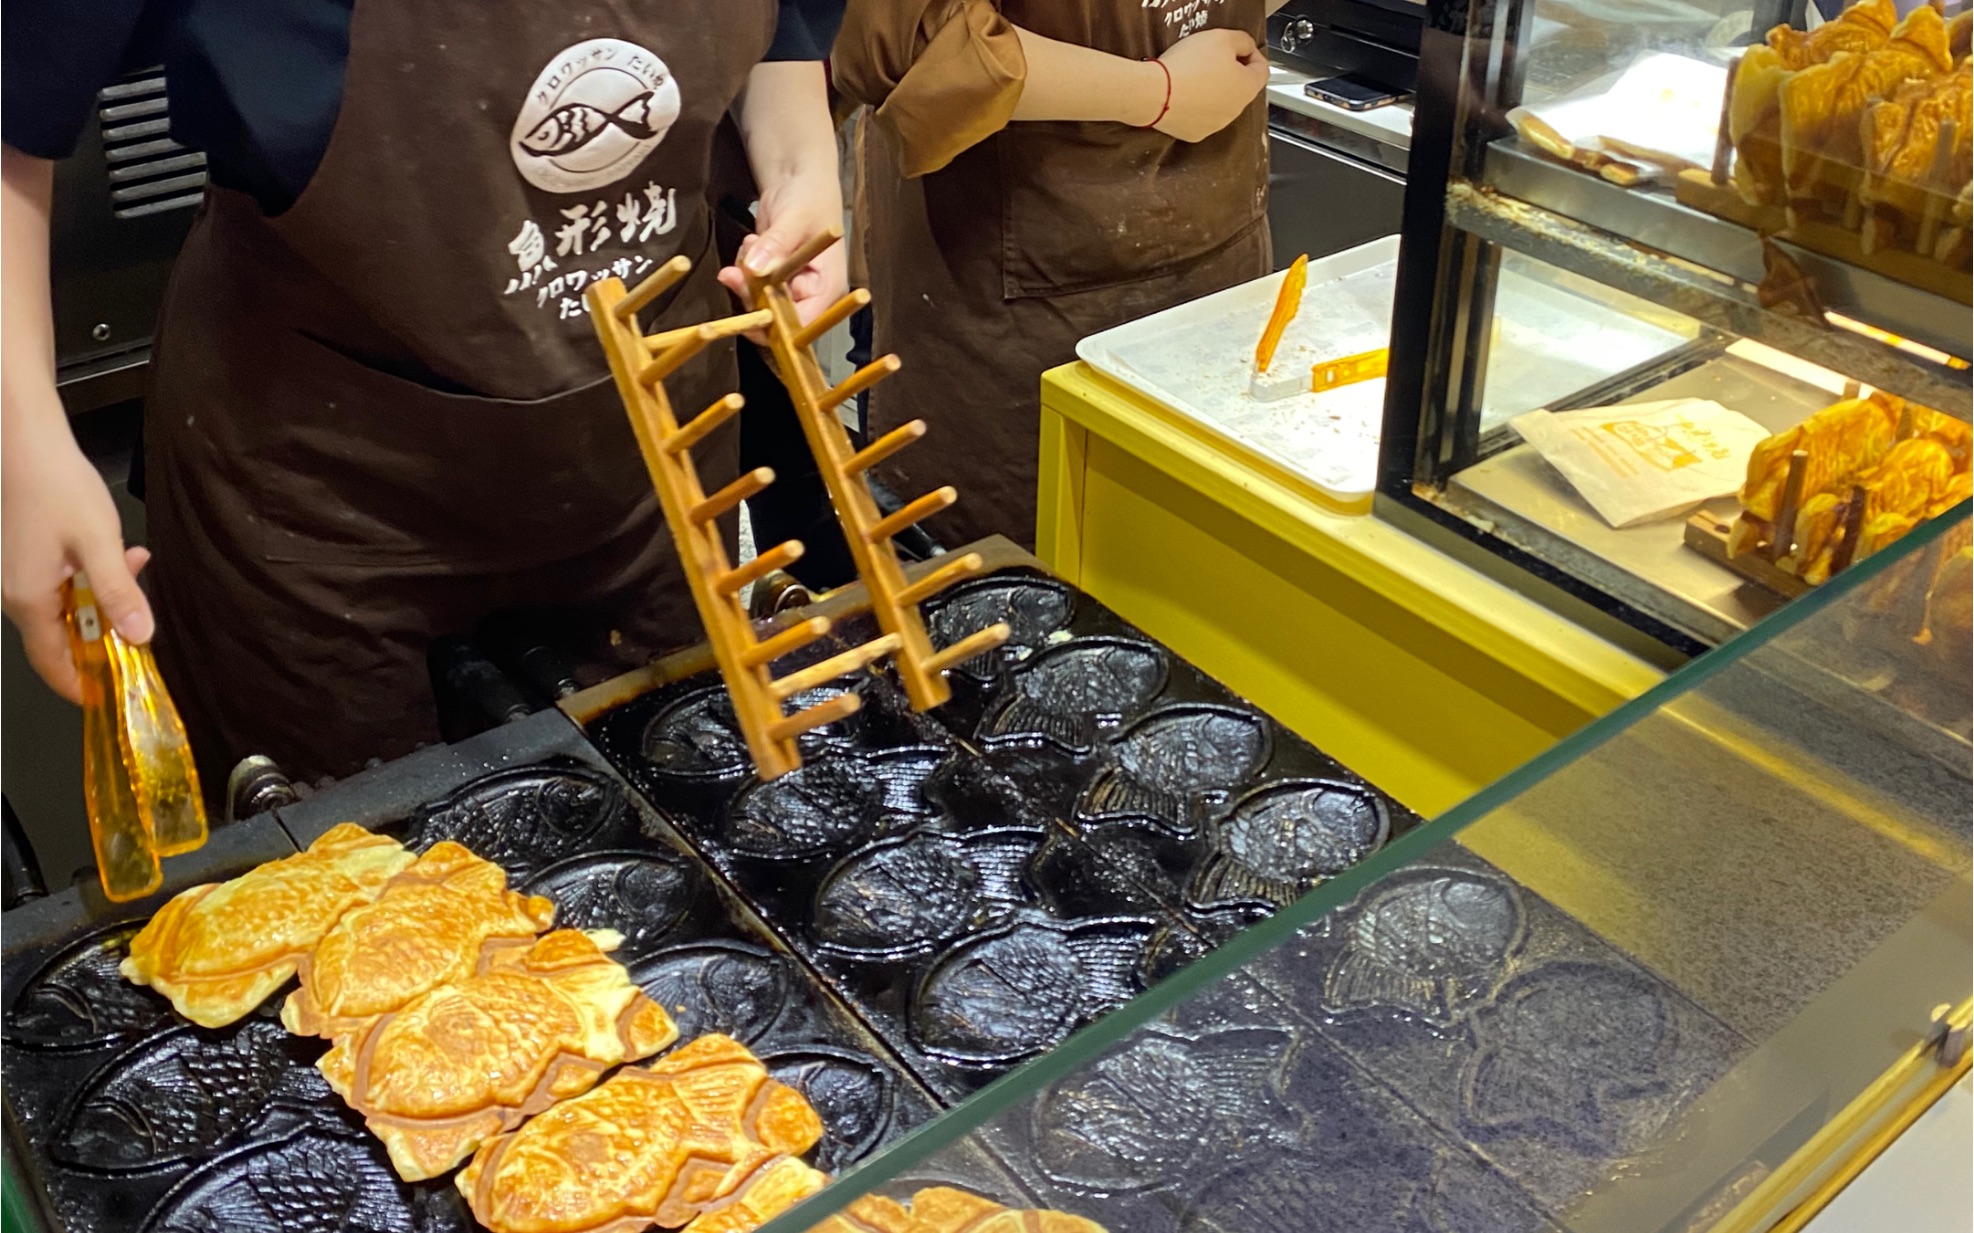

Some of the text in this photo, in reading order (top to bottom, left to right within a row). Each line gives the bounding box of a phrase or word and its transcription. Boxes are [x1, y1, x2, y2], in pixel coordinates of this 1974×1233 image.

[536, 47, 618, 104] クロワッサン
[536, 255, 653, 309] クロワッサン
